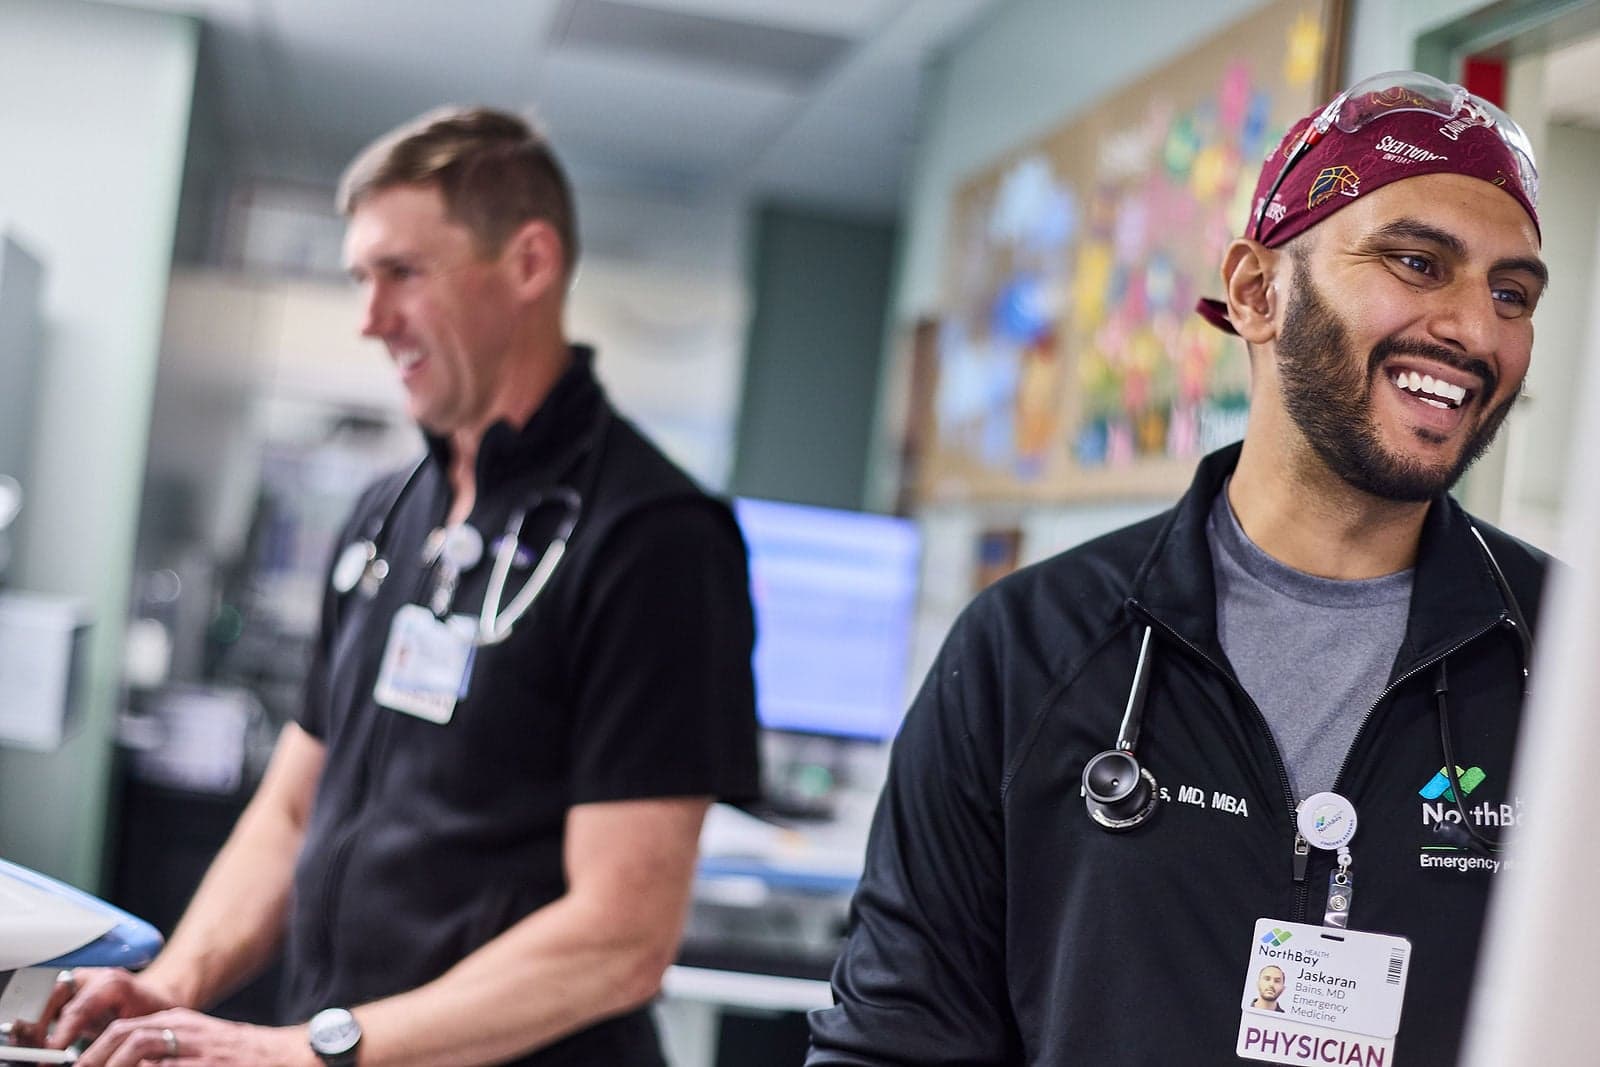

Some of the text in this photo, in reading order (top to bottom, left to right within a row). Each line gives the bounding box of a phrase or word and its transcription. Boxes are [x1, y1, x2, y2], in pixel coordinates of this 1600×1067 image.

[1376, 135, 1448, 162] AVALIERS
[1178, 785, 1205, 808] MD,
[1212, 792, 1248, 817] MBA
[1422, 802, 1522, 826] NothB
[1420, 854, 1500, 873] Emergency
[1258, 945, 1319, 967] NorthBay
[1303, 949, 1330, 959] HEALTH
[1297, 968, 1357, 989] Jaskaran
[1295, 982, 1345, 1000] Bains, MD
[1290, 1006, 1336, 1022] Medicine
[1293, 994, 1348, 1013] Emergency
[1244, 1027, 1385, 1067] PHYSICIAN
